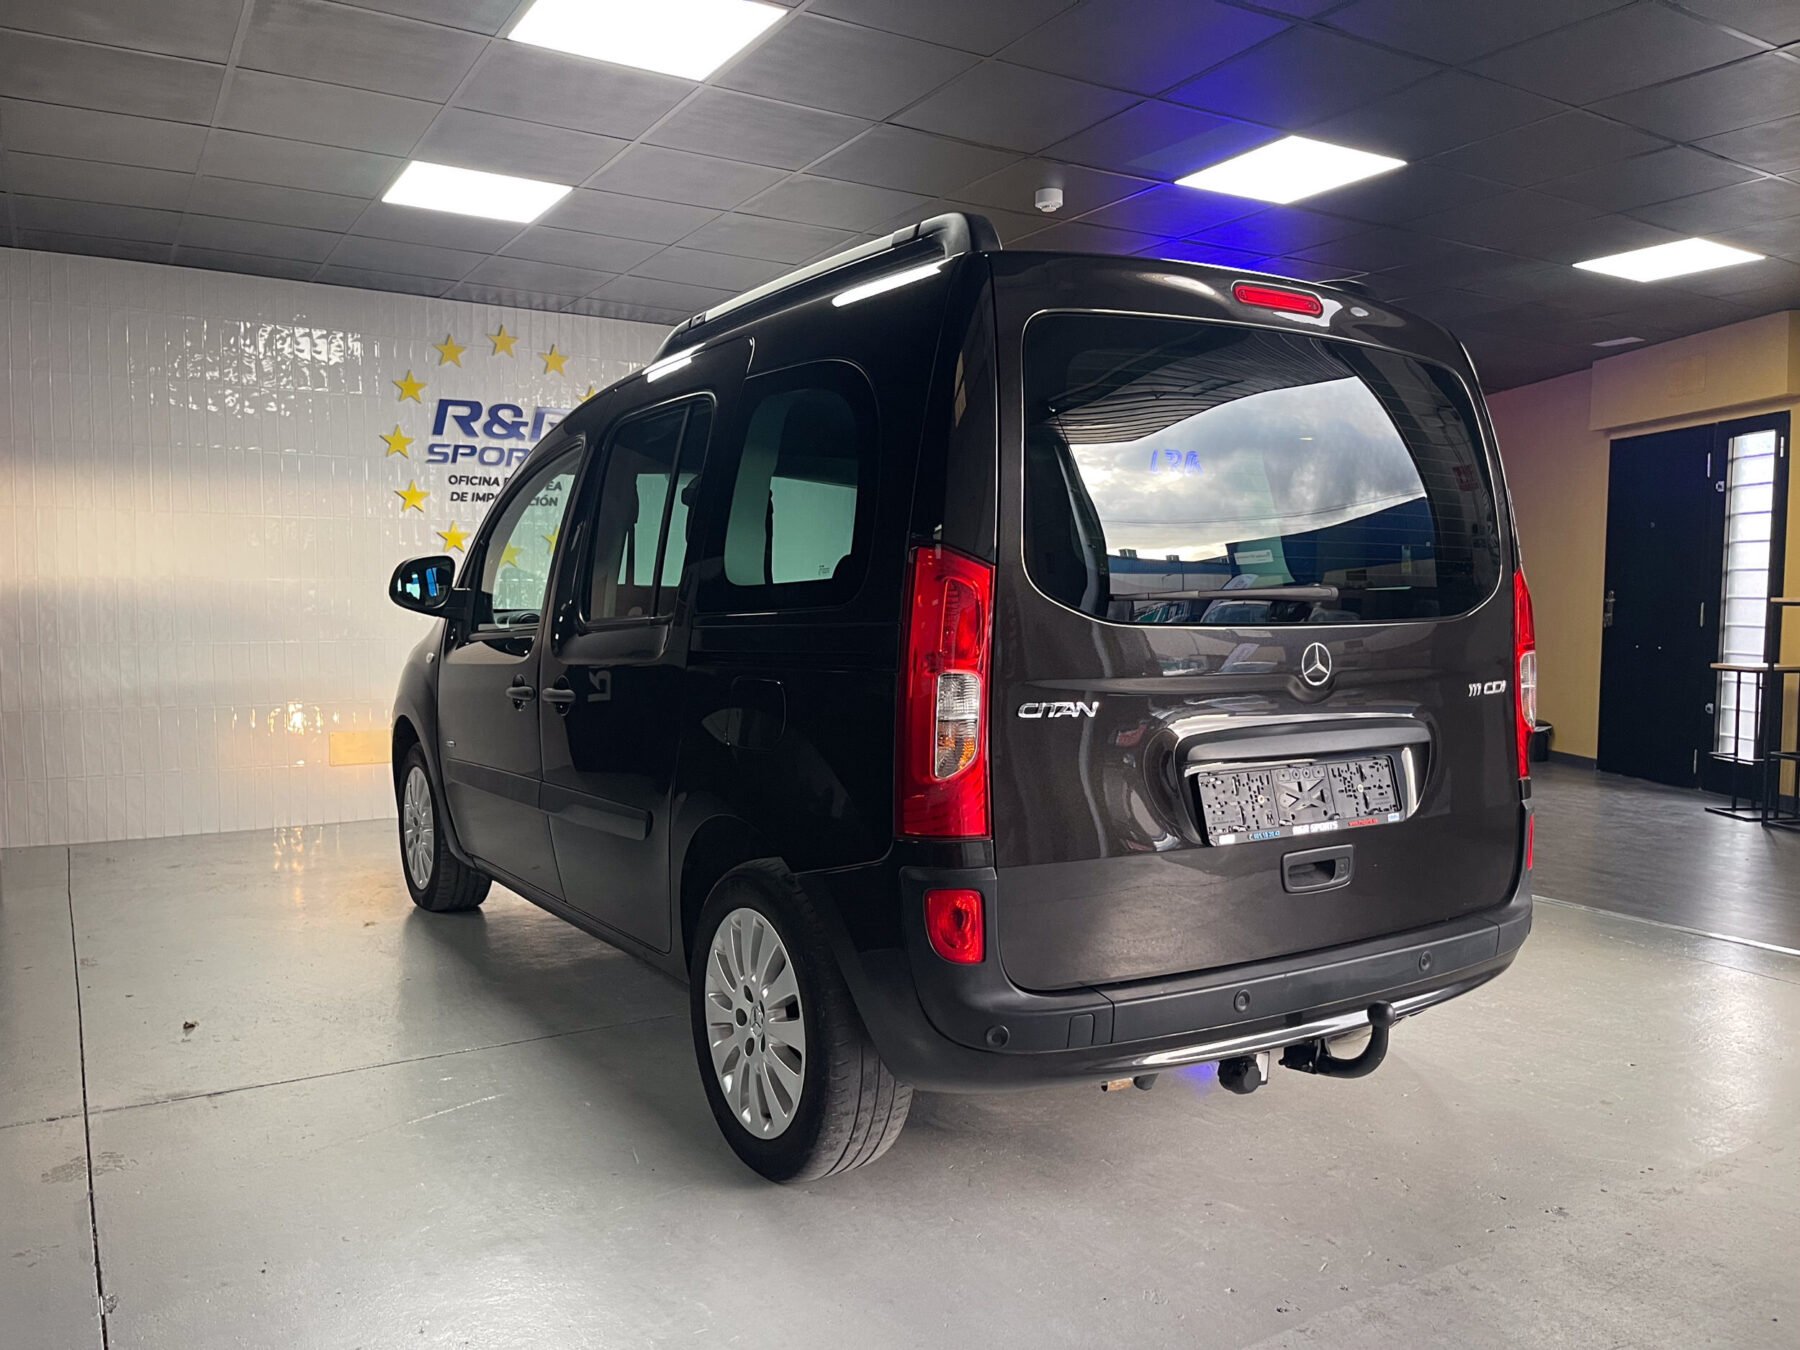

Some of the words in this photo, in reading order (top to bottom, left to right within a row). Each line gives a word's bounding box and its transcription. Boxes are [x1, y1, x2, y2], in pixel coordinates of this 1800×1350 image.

[426, 443, 530, 466] SPOR
[448, 475, 500, 486] OFICINA
[450, 491, 468, 502] DE
[1483, 680, 1506, 694] CDI
[1017, 701, 1100, 718] CITAN
